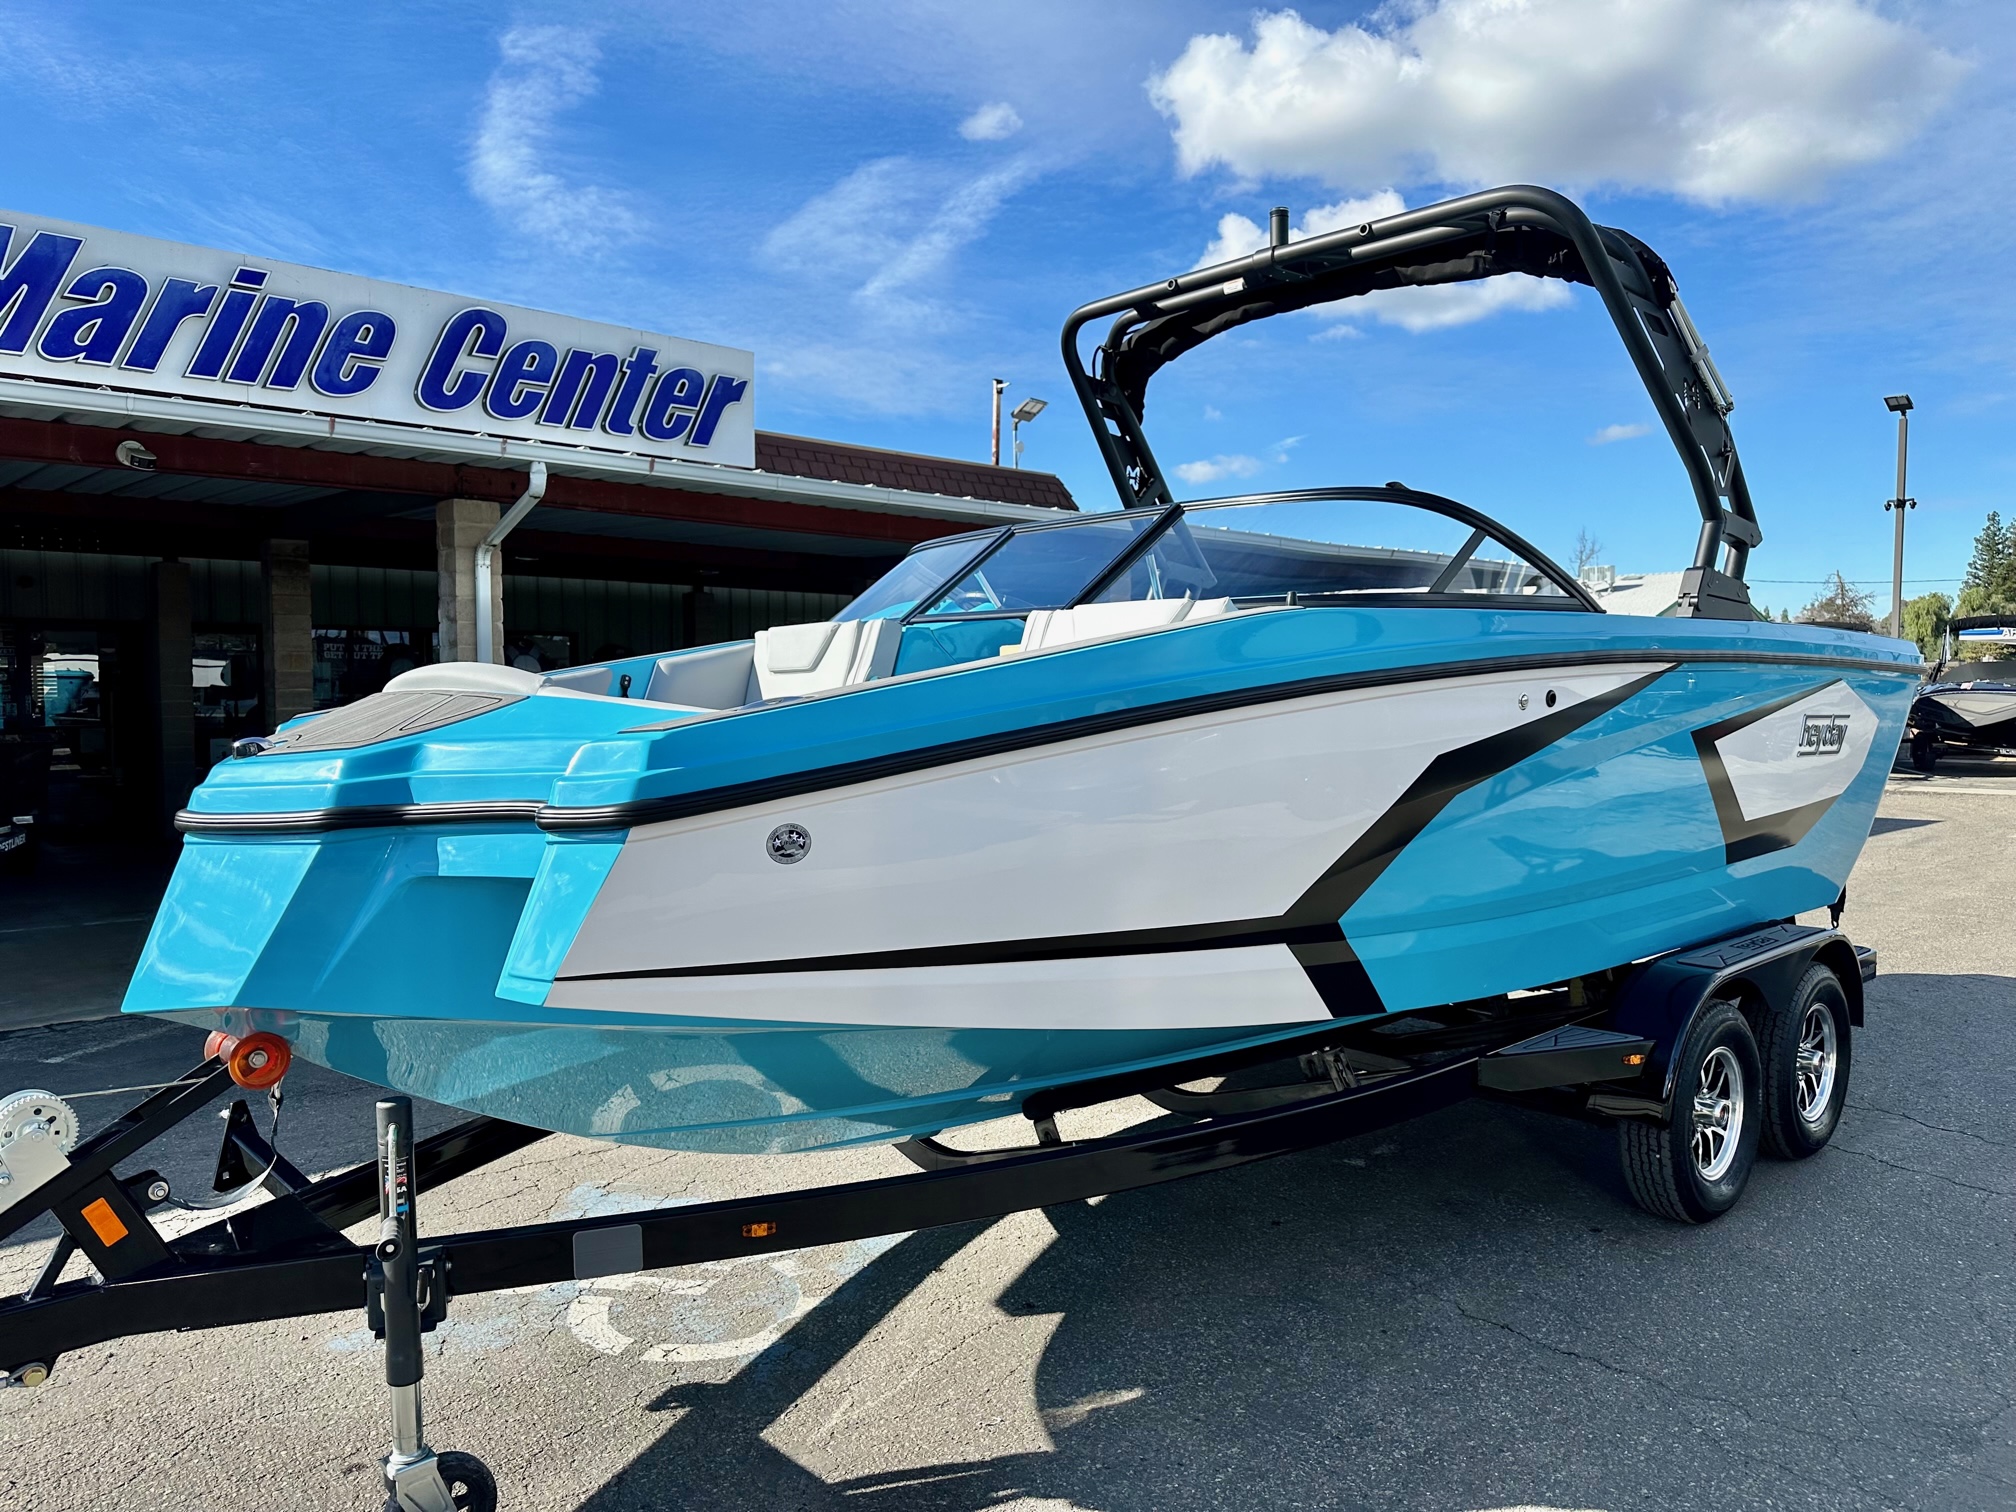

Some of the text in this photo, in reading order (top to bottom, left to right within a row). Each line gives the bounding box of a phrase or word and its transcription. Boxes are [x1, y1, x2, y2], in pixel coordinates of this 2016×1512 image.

[0, 224, 749, 448] Marine Center
[323, 643, 345, 651] PUT
[323, 651, 345, 659] GET
[1797, 714, 1851, 757] heyday
[0, 833, 26, 851] ESTLINER
